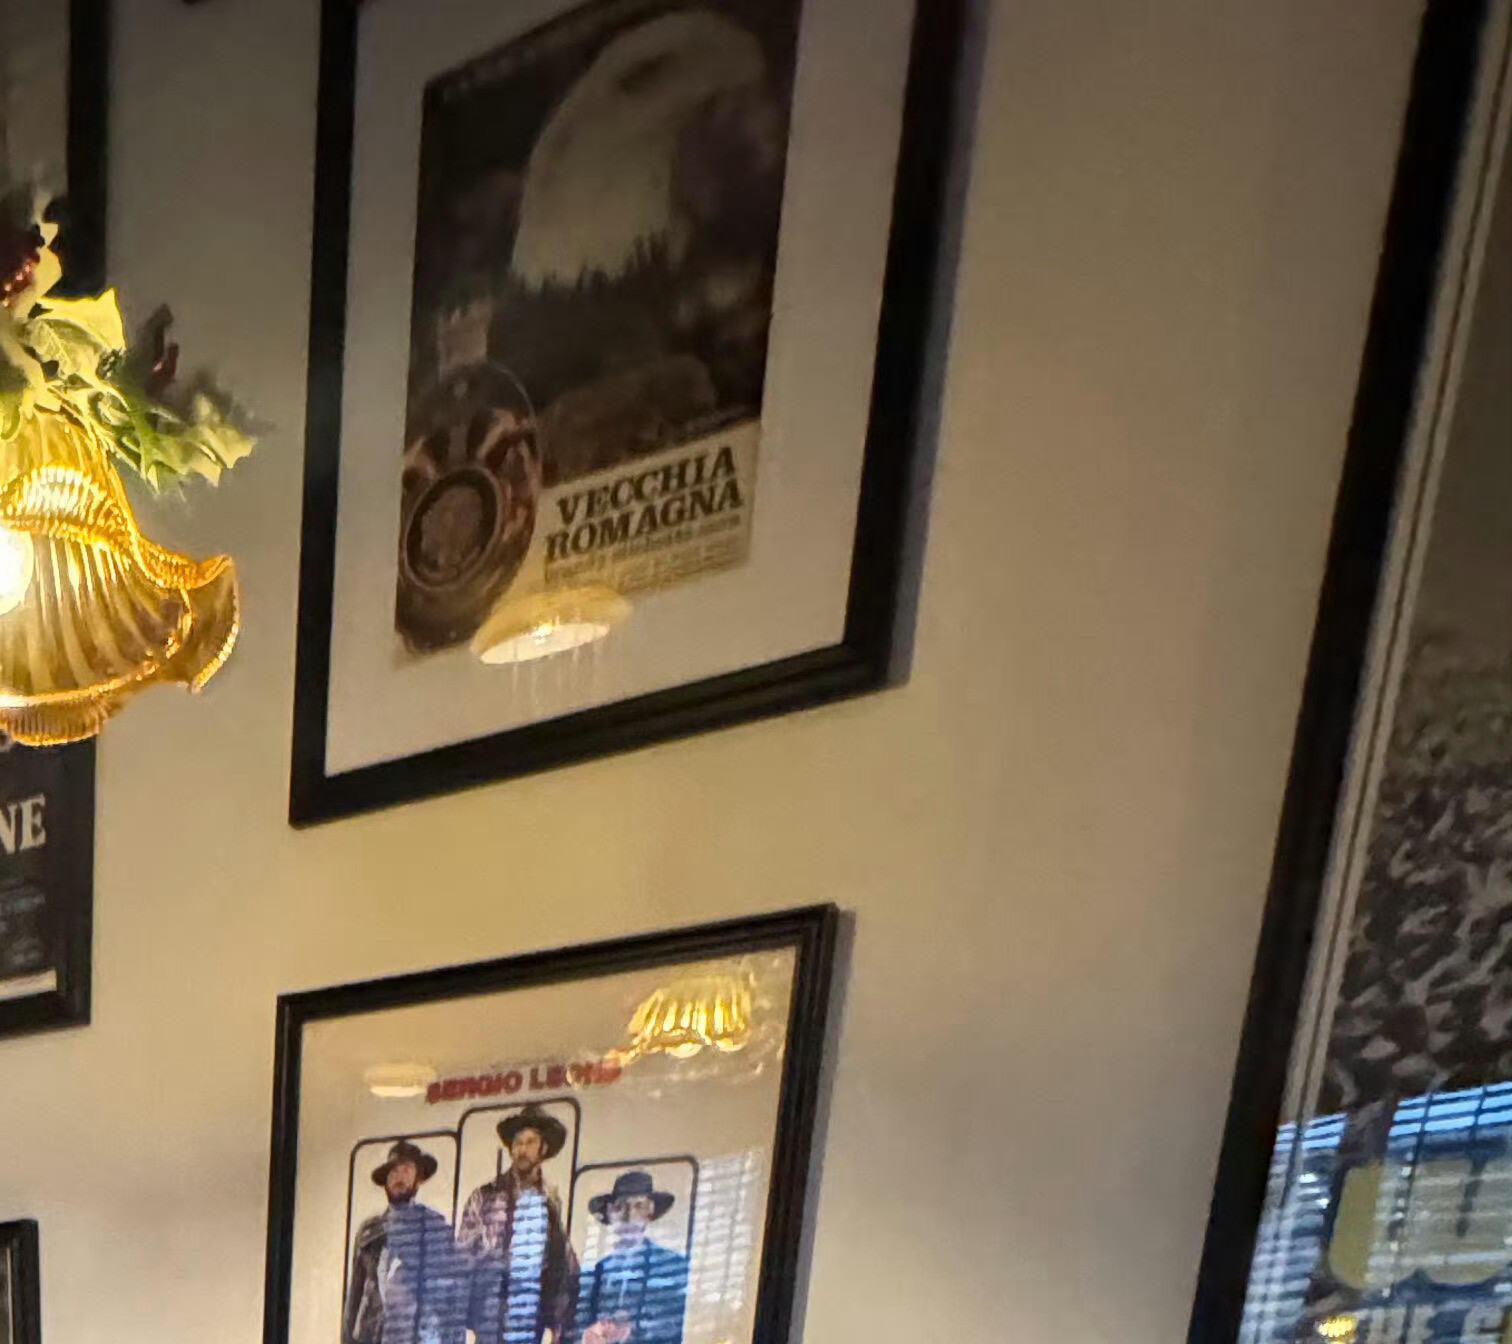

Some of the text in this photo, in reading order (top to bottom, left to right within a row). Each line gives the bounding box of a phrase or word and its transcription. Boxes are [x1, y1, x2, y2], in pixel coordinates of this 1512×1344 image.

[544, 479, 744, 562] ROMAGNA
[556, 446, 736, 525] VECCHIA
[425, 1069, 523, 1103] SERGIO
